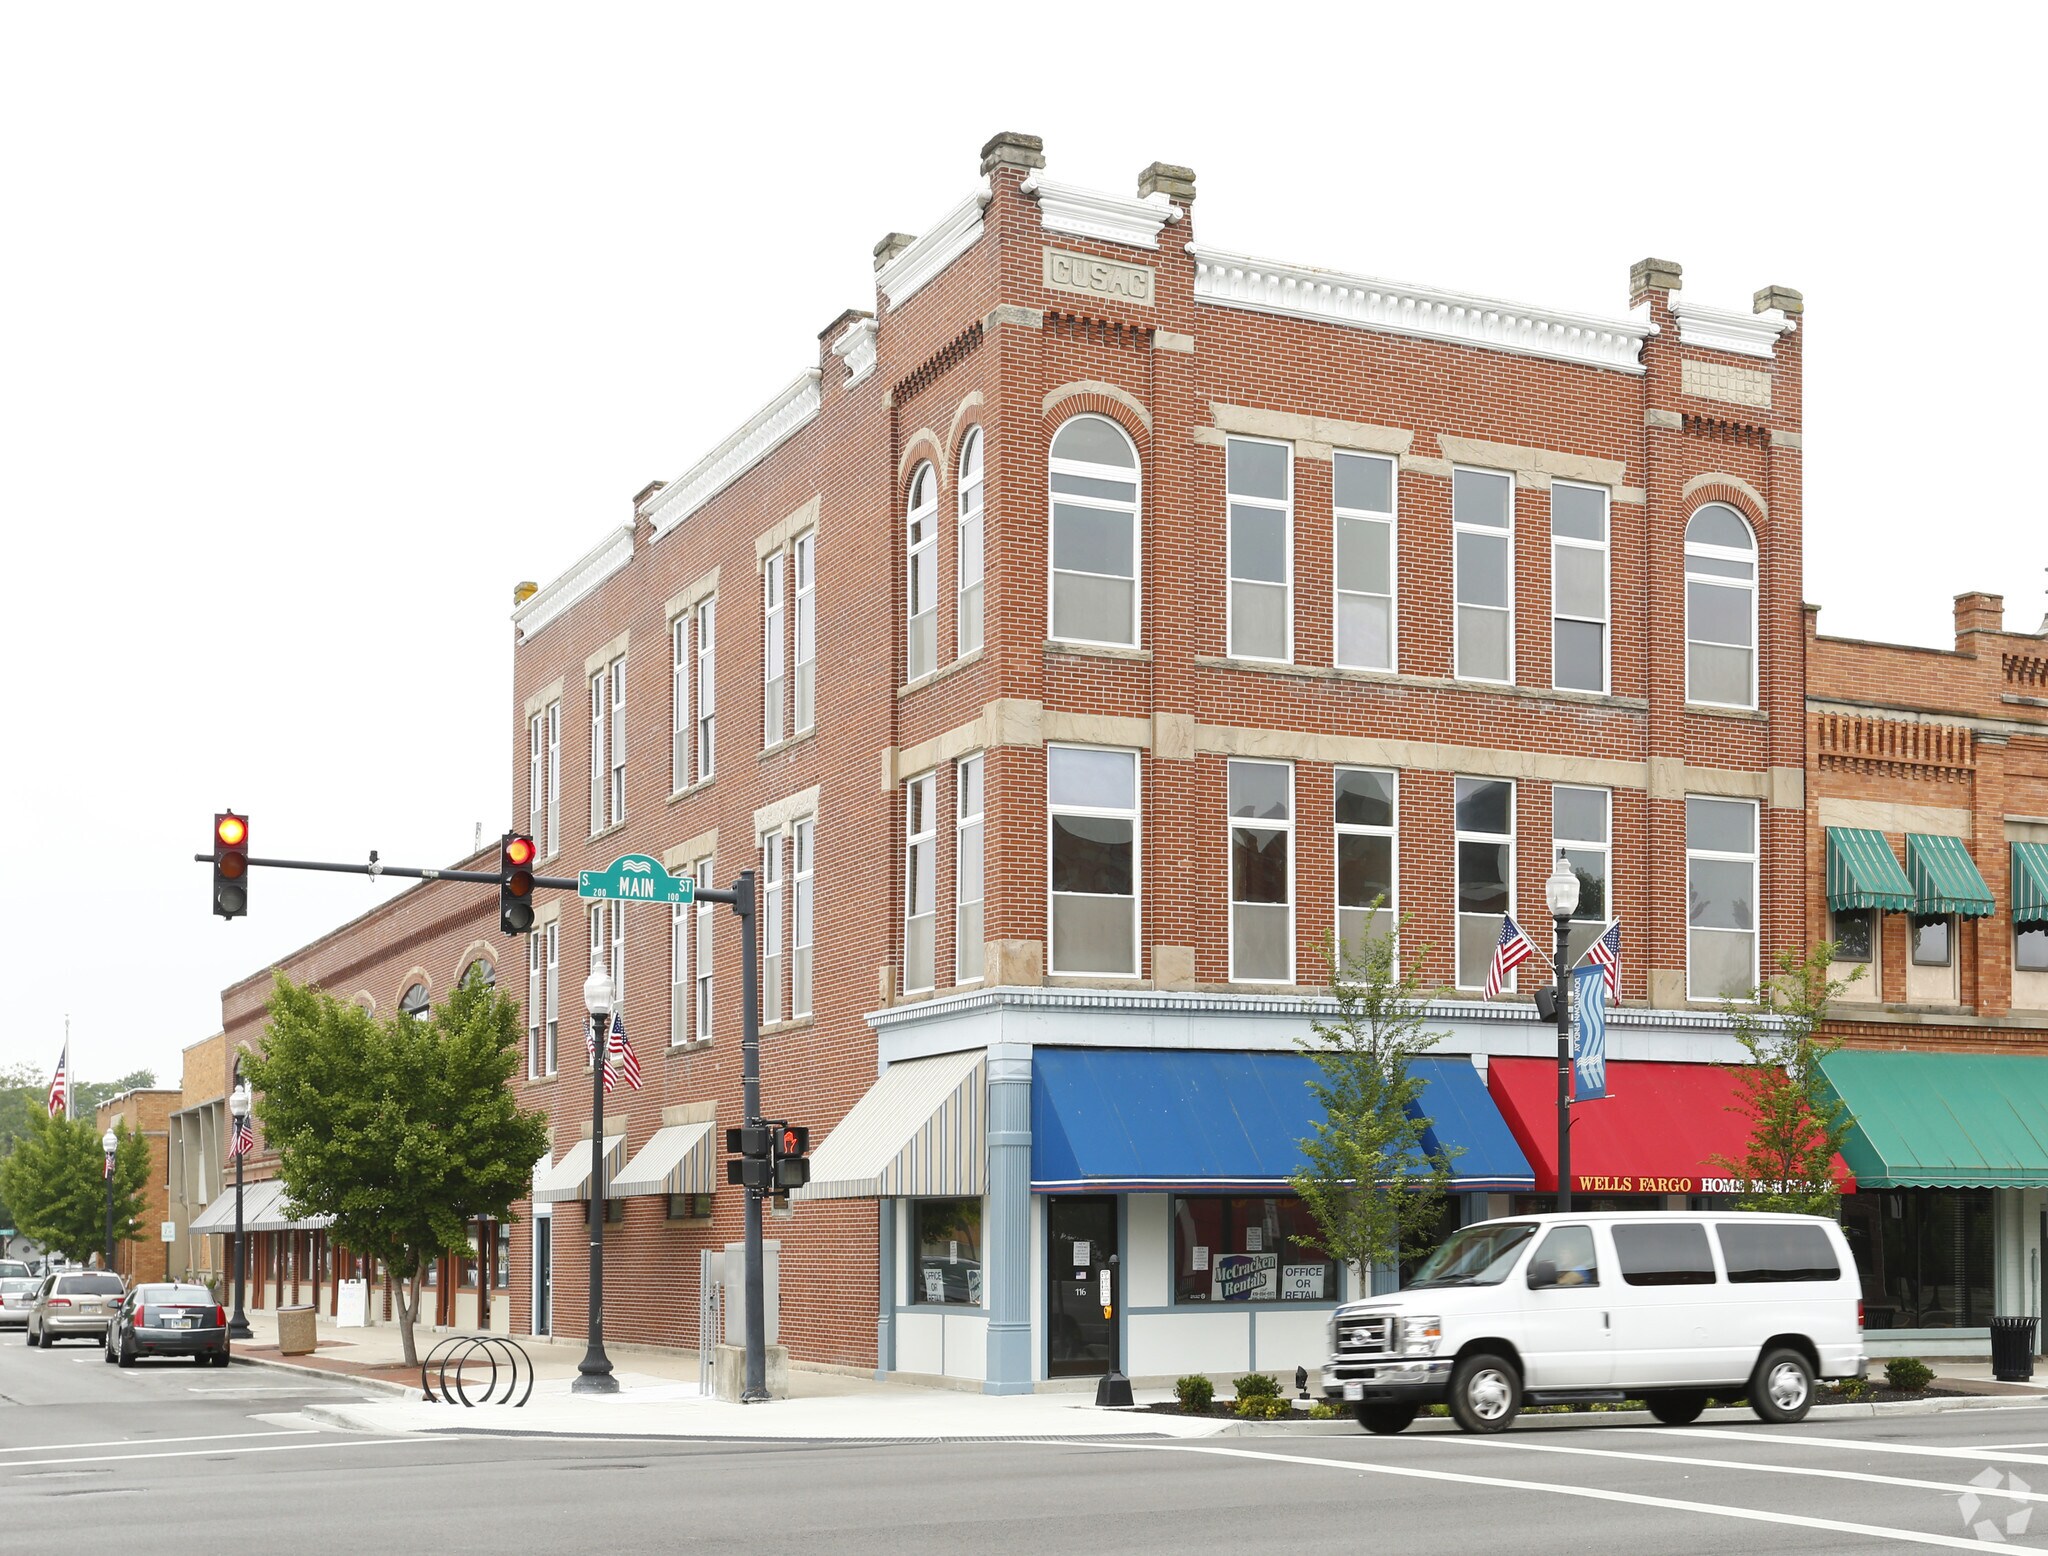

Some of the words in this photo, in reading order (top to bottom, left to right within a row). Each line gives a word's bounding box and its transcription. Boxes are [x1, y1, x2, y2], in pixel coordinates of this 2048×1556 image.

[1053, 255, 1147, 298] CUSAC
[619, 876, 654, 898] MAIN
[593, 888, 606, 897] 200
[668, 892, 680, 902] 100
[1579, 1176, 1632, 1191] WELLS
[1638, 1177, 1692, 1192] FARGO
[1701, 1177, 1745, 1193] HOME
[1215, 1255, 1276, 1283] McCracken
[1285, 1267, 1323, 1277] OFFICE
[1224, 1272, 1267, 1297] Rentals
[1295, 1279, 1311, 1288] OR
[1075, 1288, 1087, 1296] 116
[1285, 1290, 1320, 1299] RETAIL
